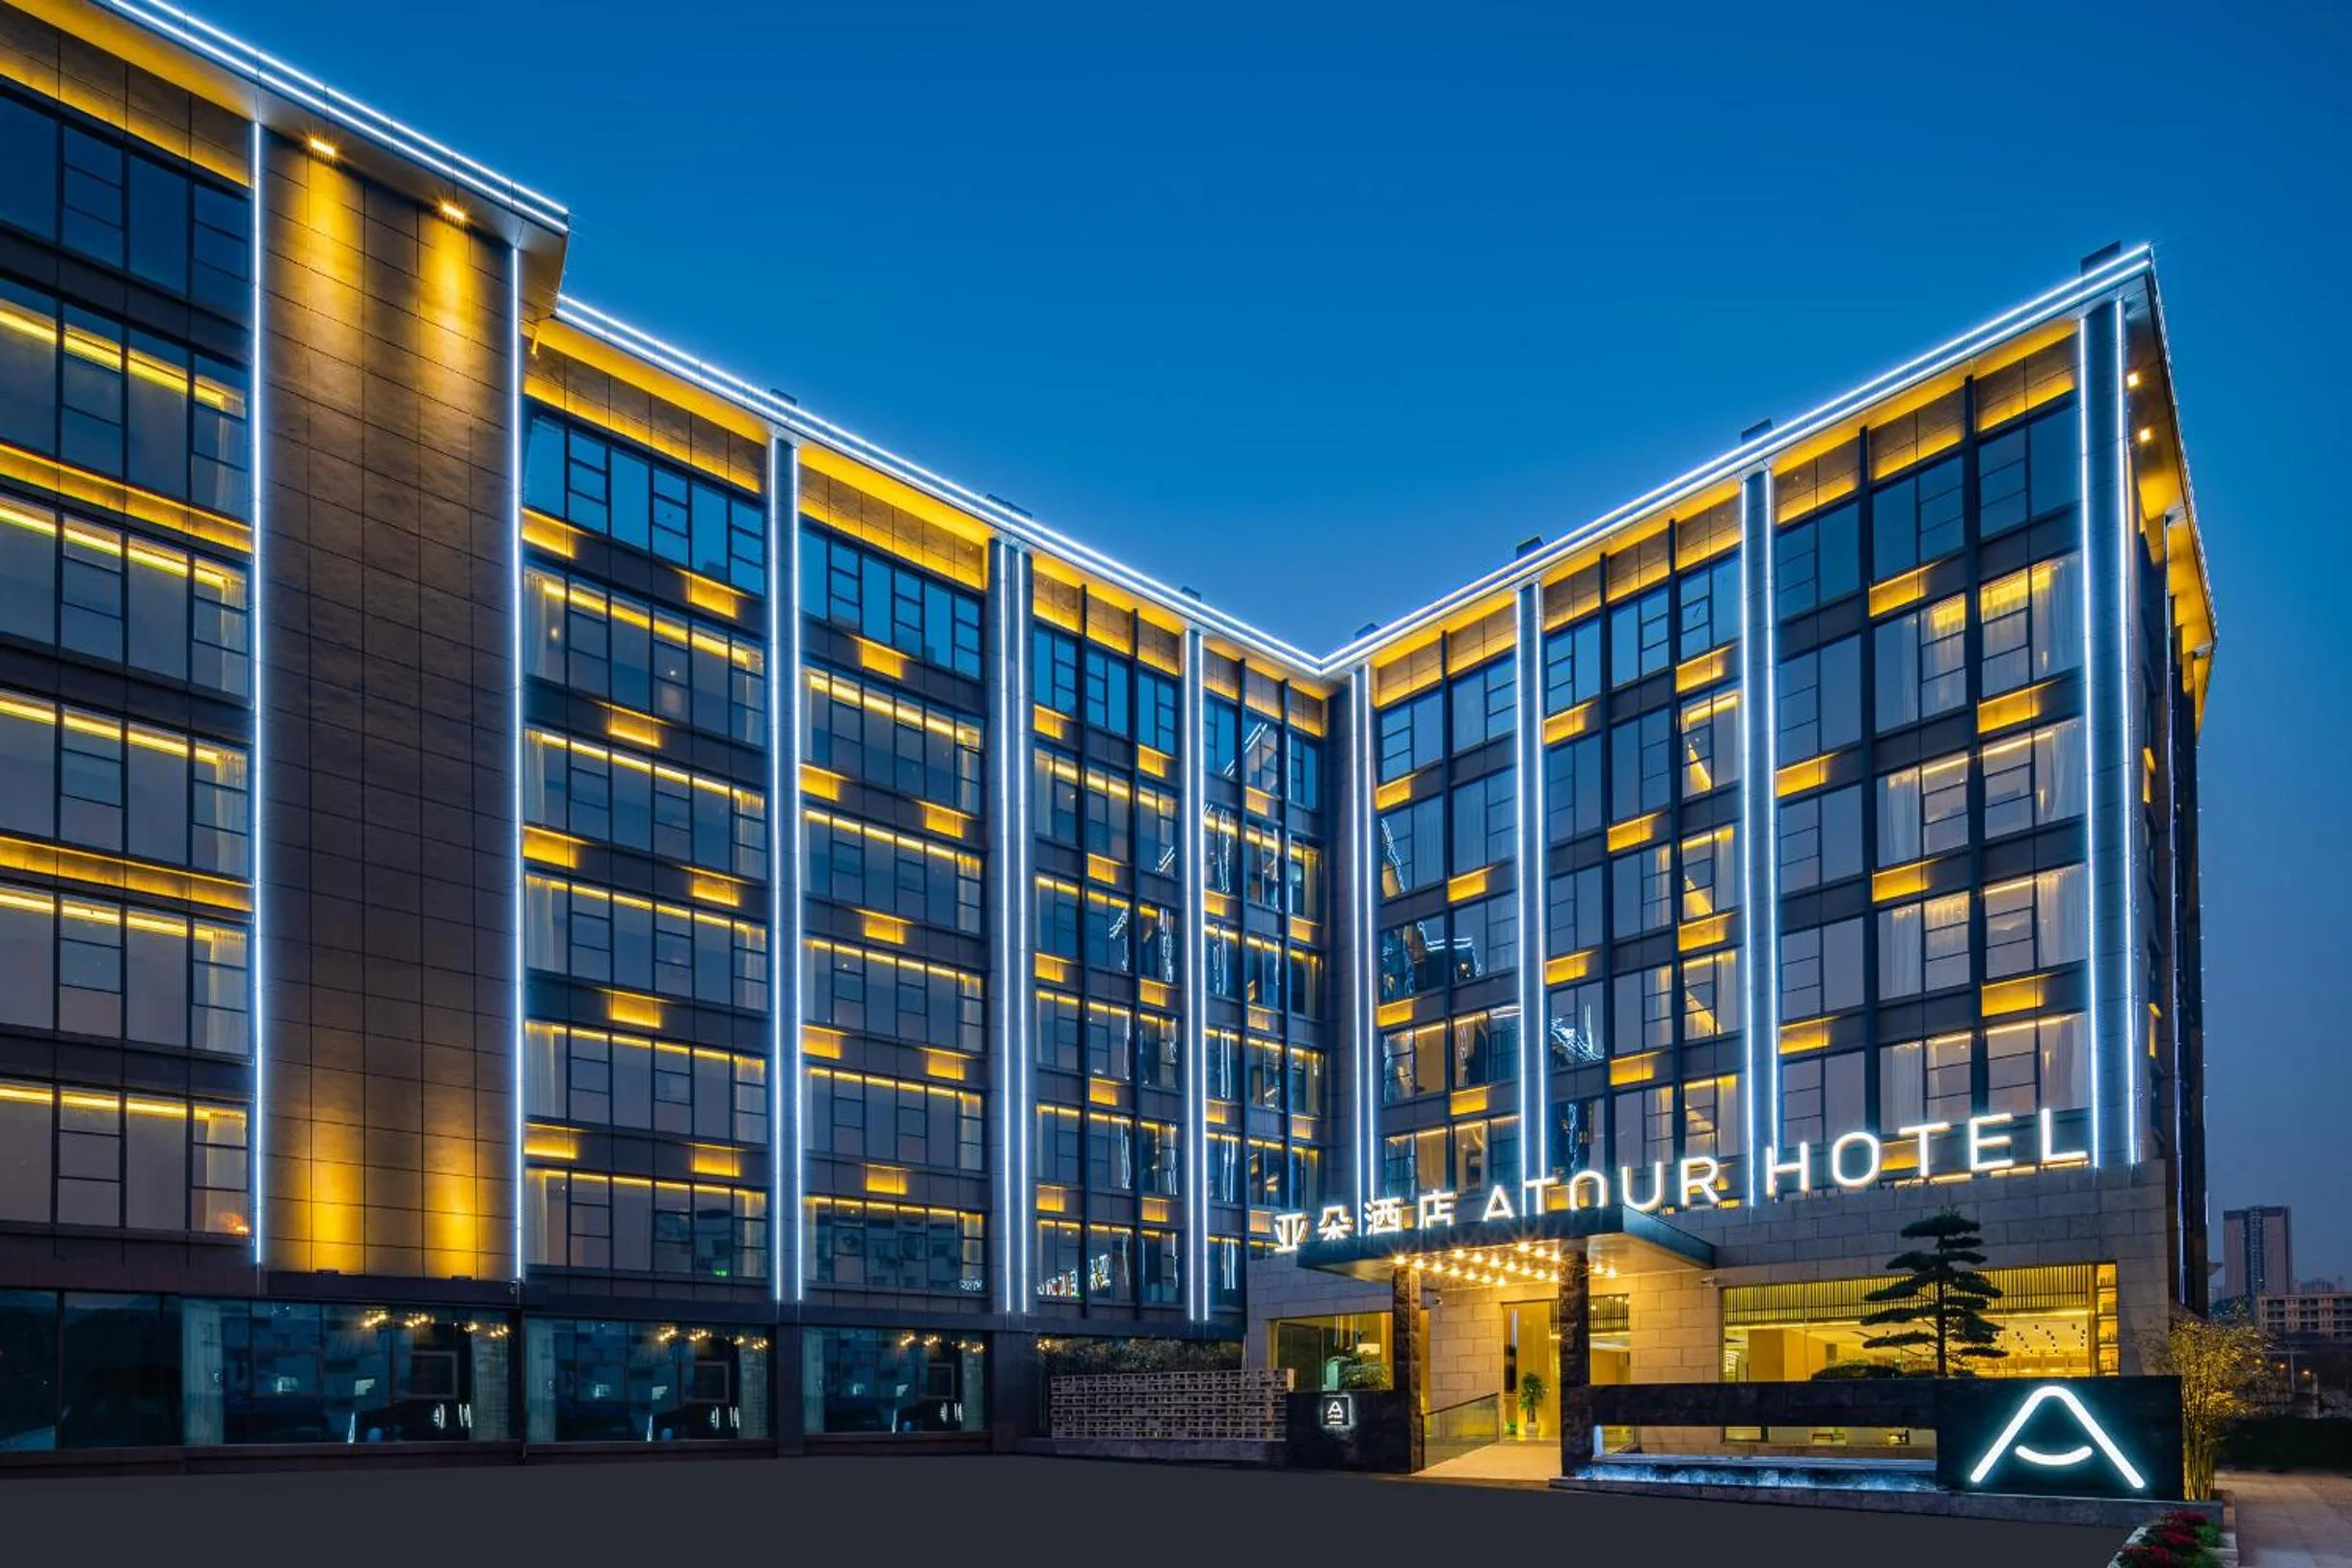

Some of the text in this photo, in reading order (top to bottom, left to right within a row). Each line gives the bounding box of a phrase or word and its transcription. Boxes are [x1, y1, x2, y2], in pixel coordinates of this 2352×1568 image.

[1483, 1108, 2089, 1222] ATOUR HOTEL
[1274, 1190, 1457, 1253] 亚朵酒店
